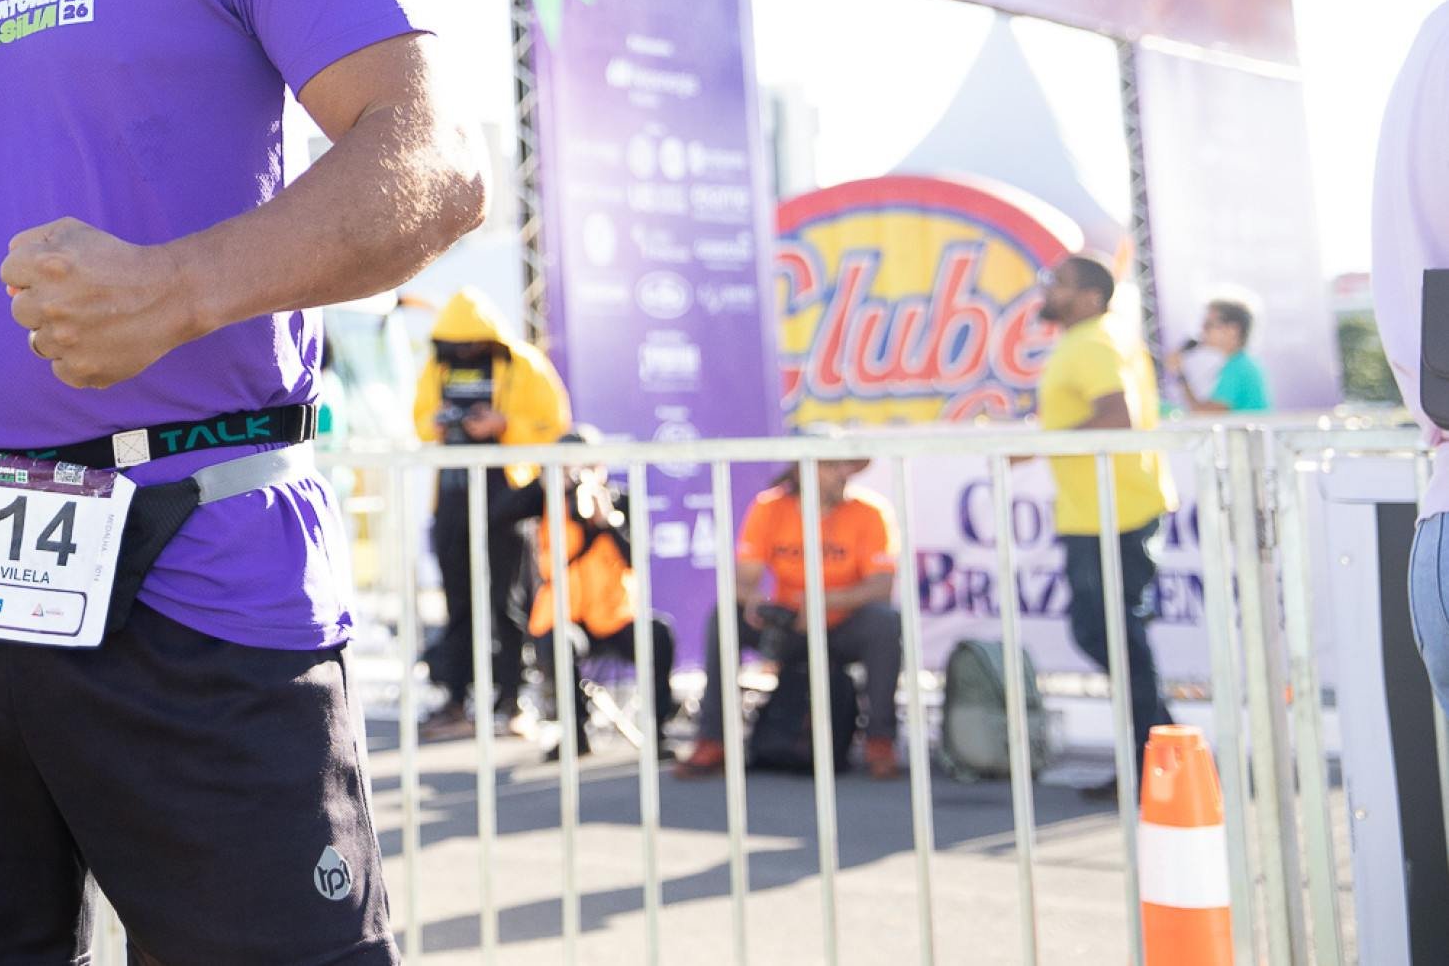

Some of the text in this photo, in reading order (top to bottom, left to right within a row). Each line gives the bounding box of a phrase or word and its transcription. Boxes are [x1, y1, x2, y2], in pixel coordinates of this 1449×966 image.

[63, 3, 89, 21] 26
[159, 416, 271, 453] TALK
[0, 566, 50, 584] VILELA
